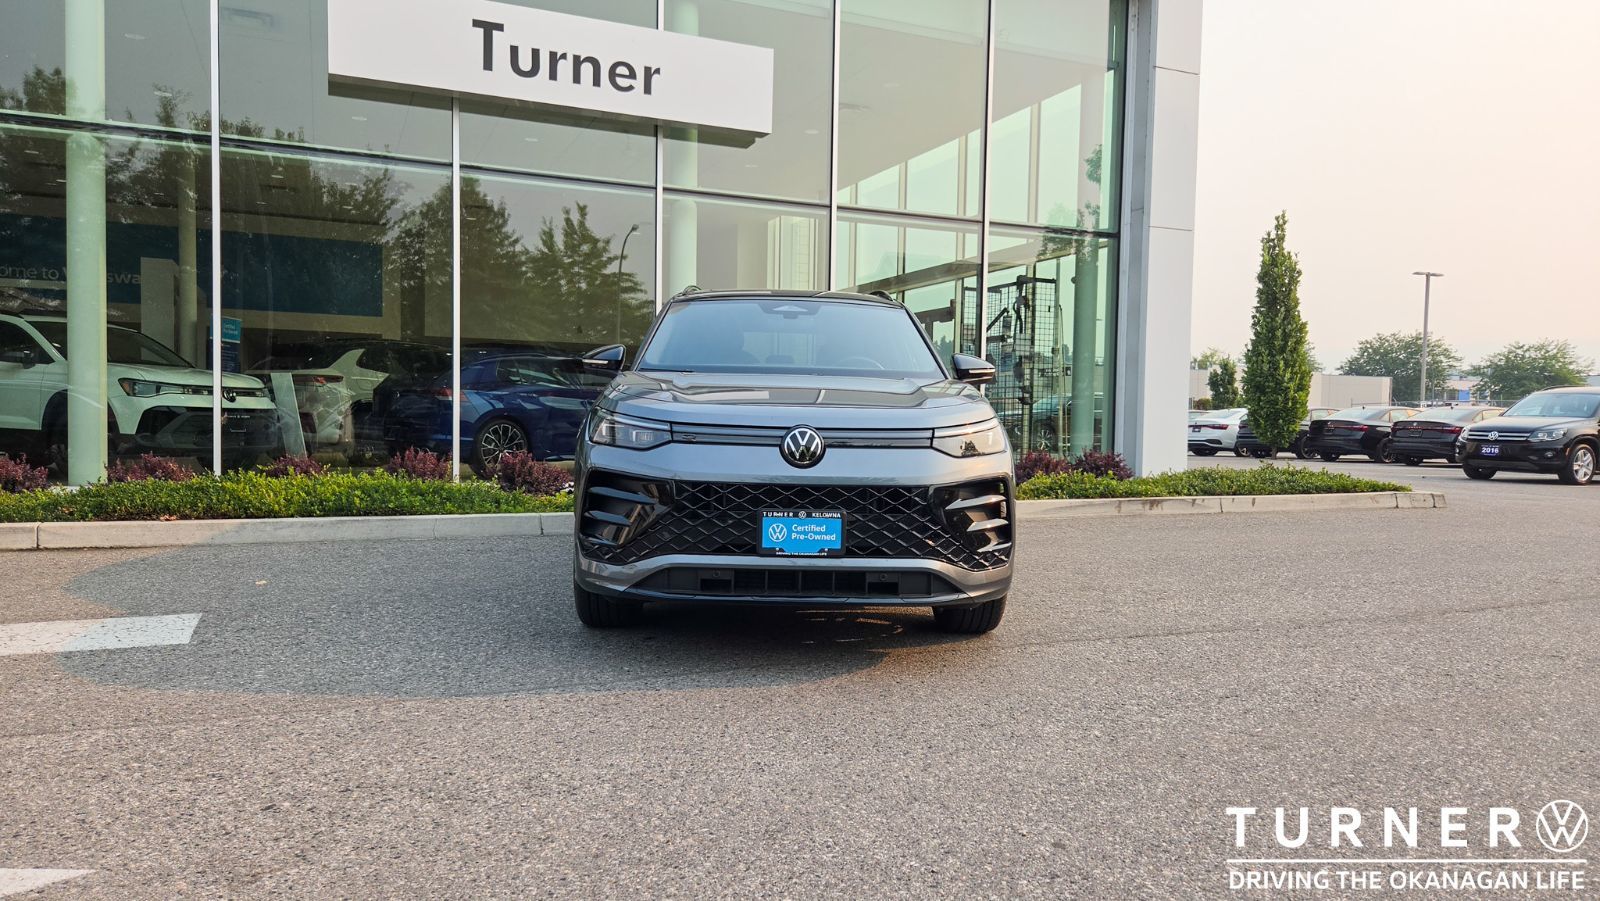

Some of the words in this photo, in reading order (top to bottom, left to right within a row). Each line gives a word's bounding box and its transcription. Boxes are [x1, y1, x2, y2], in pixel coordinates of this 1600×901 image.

[472, 18, 661, 95] Turner
[792, 524, 826, 532] Certified
[791, 533, 836, 541] Pre-Owned
